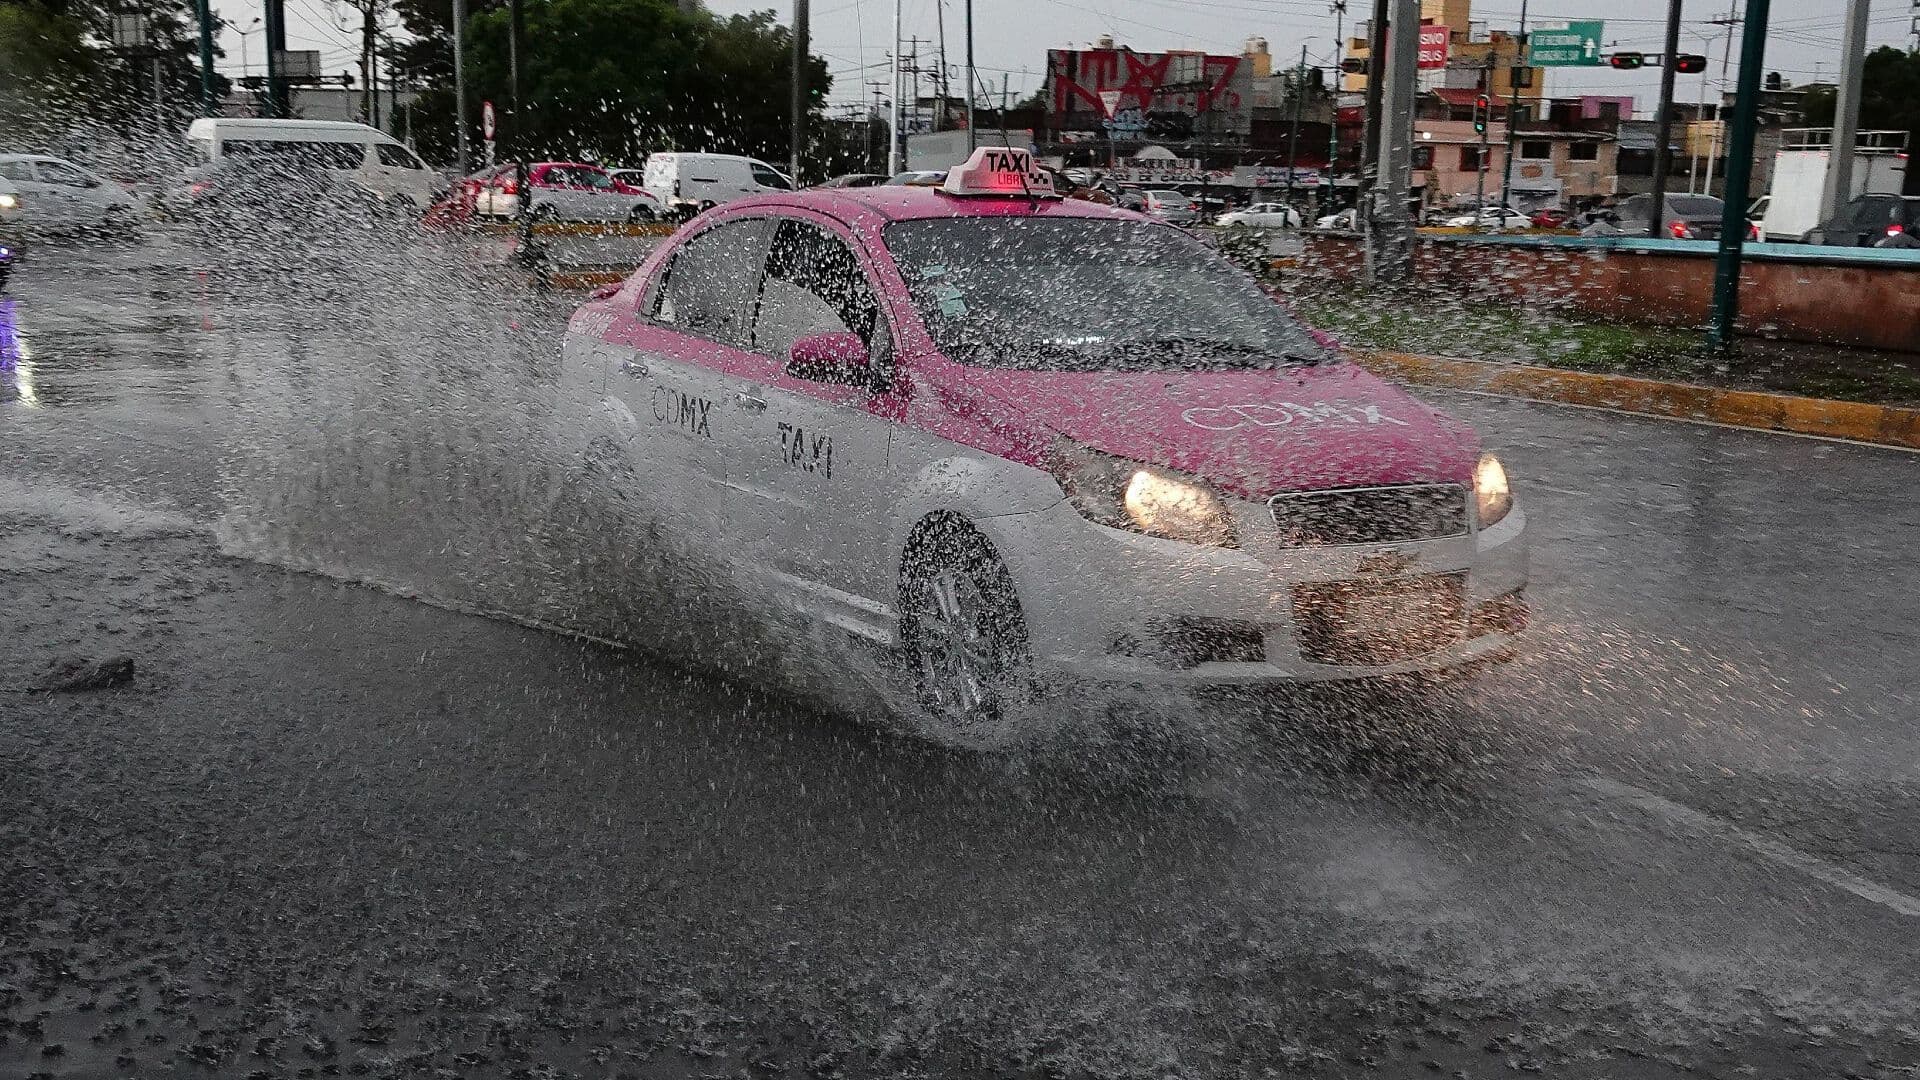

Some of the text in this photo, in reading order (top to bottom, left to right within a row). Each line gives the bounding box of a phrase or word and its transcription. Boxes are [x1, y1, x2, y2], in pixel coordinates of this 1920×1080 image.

[986, 152, 1030, 172] TAXI
[652, 385, 712, 438] CDMX
[1181, 401, 1411, 431] CDMX
[778, 421, 833, 480] TAXI
